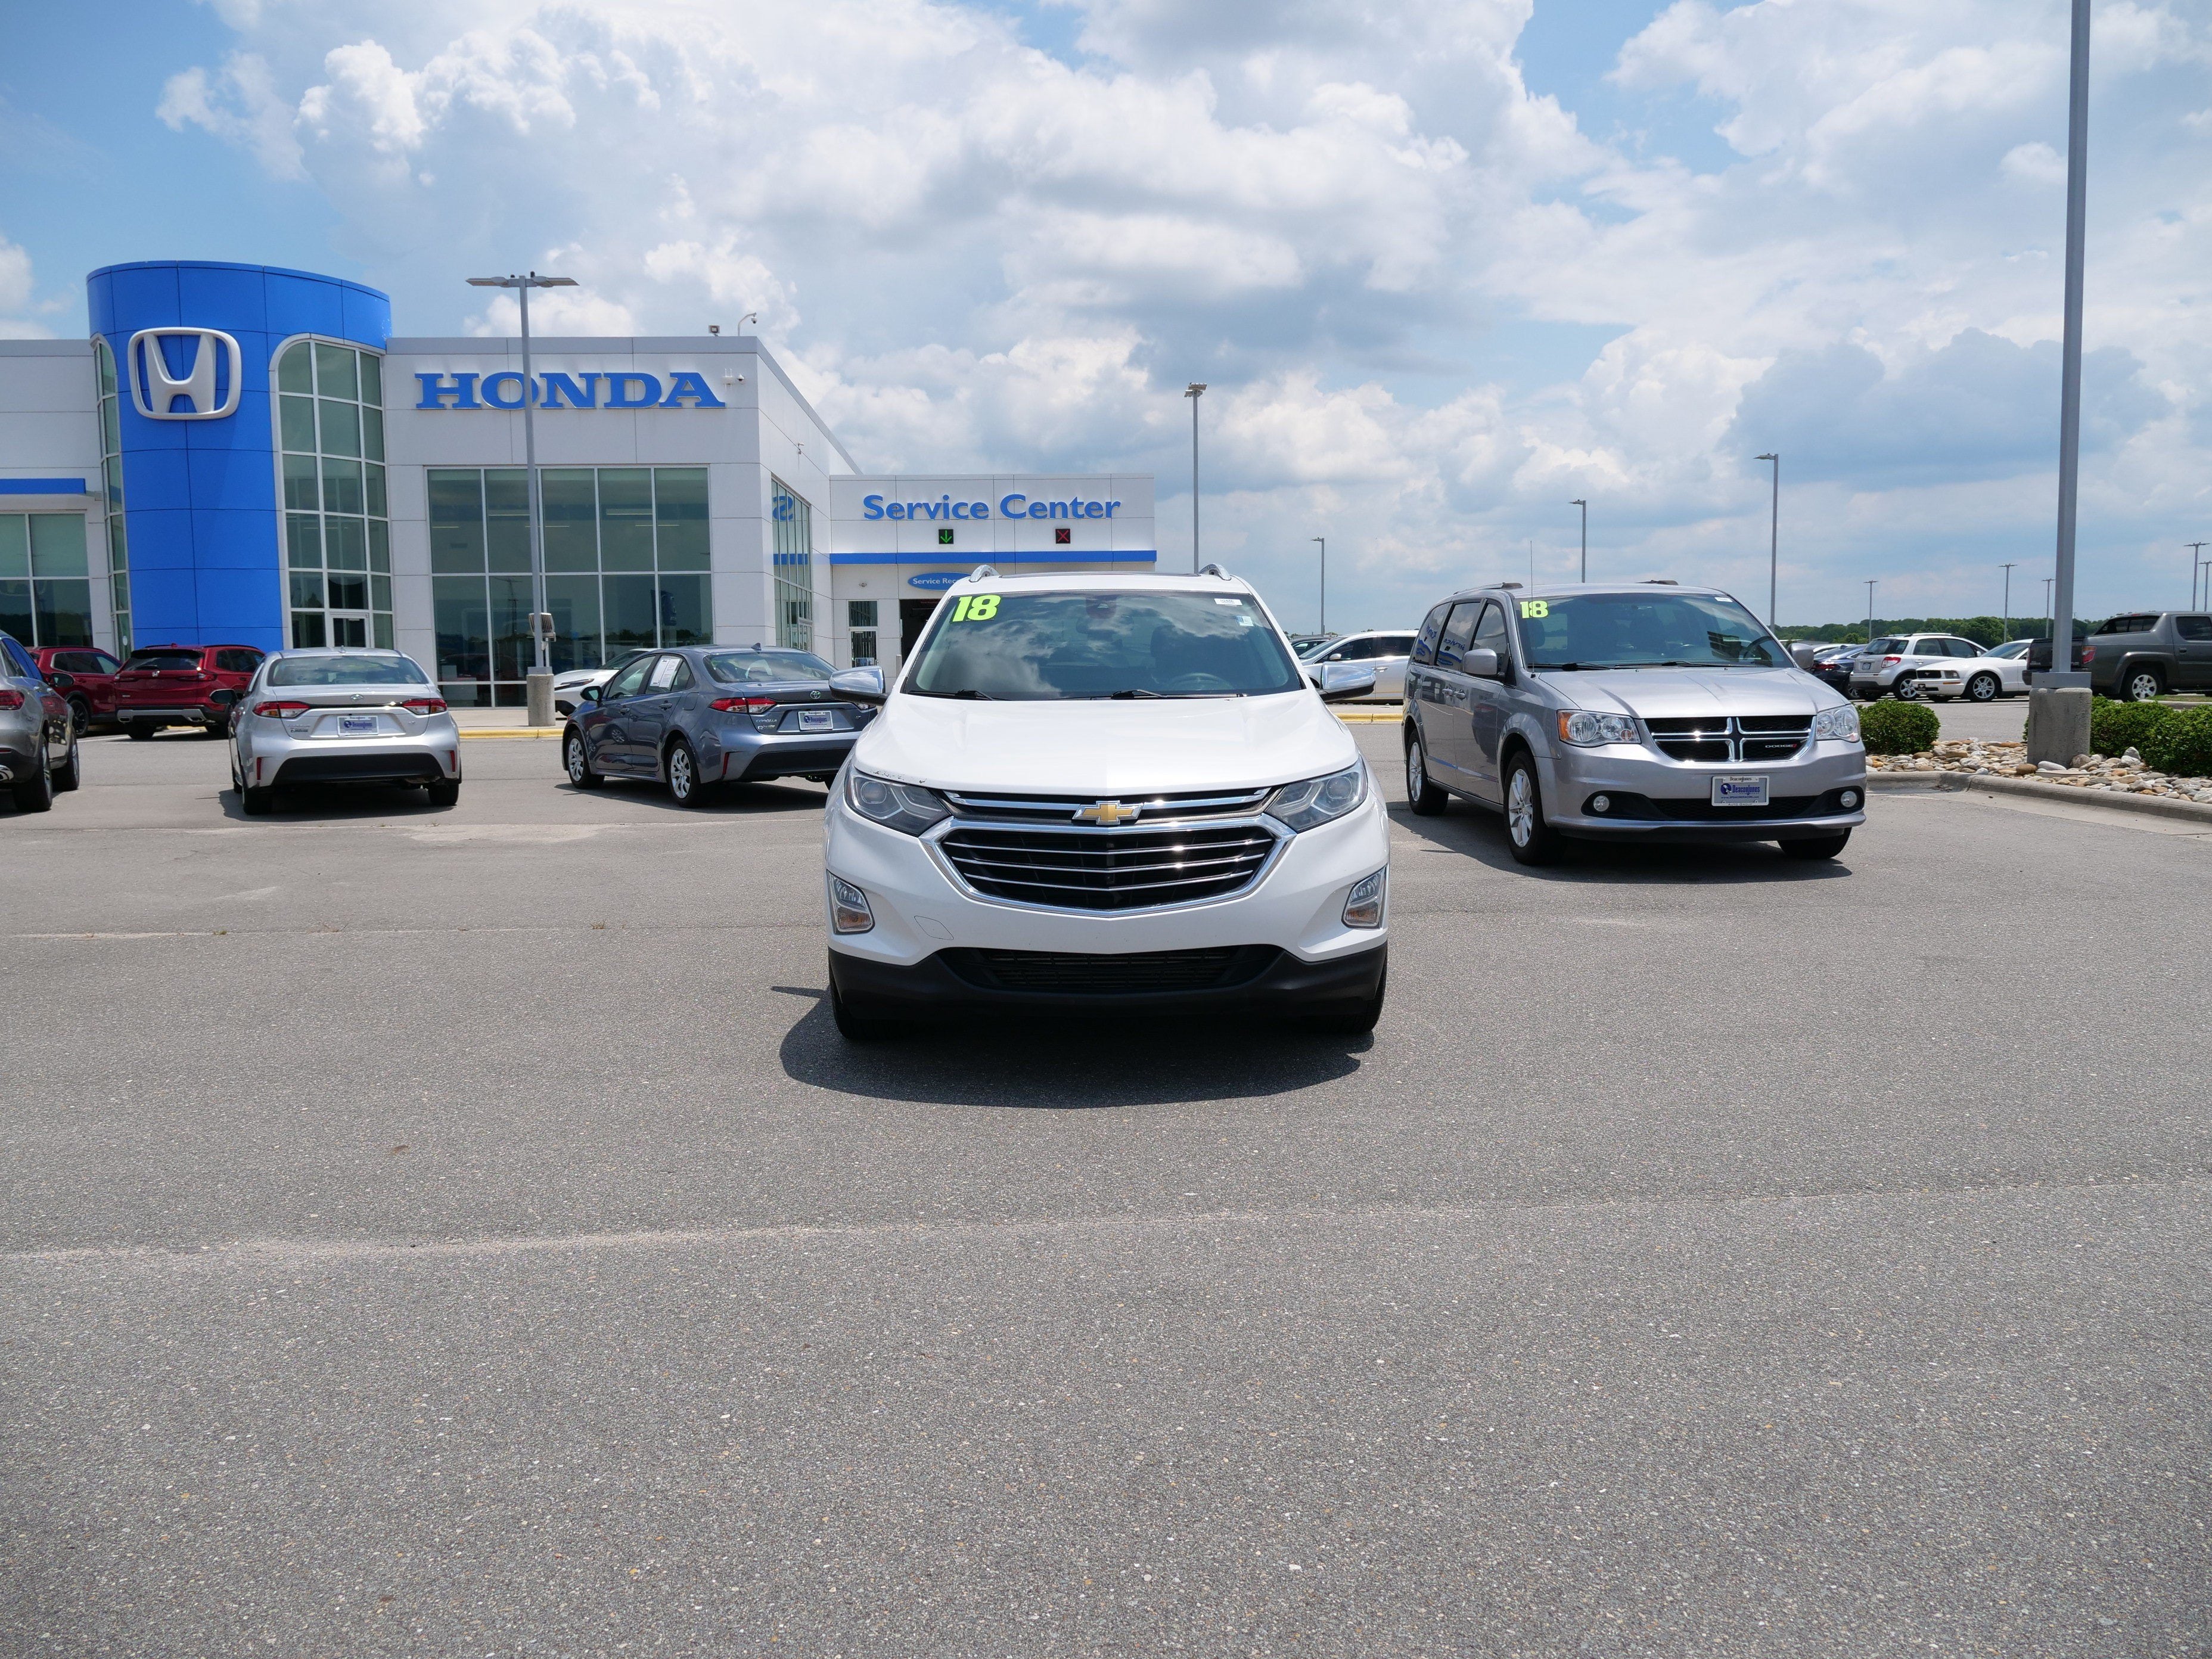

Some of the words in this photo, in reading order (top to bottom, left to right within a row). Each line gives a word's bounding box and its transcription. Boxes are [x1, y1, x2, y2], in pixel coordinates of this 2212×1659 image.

[415, 372, 726, 409] HONDA
[863, 495, 989, 520] Service
[1000, 494, 1121, 519] Center
[952, 595, 1001, 622] 18
[1520, 600, 1548, 619] 18
